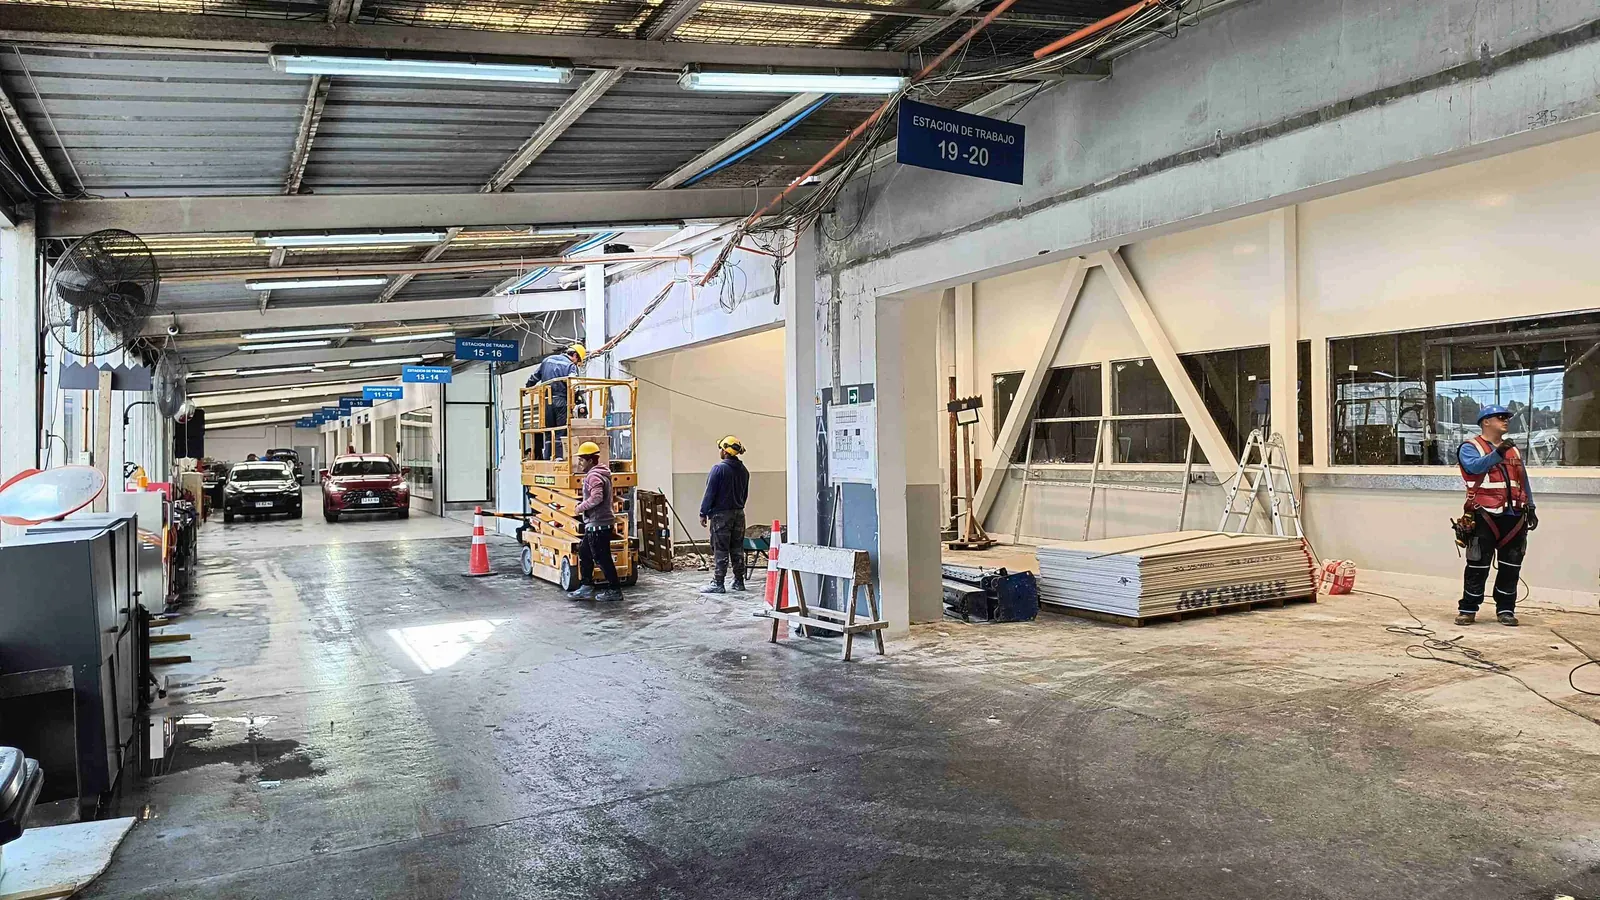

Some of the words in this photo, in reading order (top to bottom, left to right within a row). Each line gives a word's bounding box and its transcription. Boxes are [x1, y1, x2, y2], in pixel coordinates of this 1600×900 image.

[913, 115, 959, 134] ESTACION
[961, 126, 973, 137] DE
[975, 128, 1015, 145] TRABAJO
[938, 140, 959, 161] 19
[473, 349, 485, 357] 15
[491, 349, 502, 358] 16
